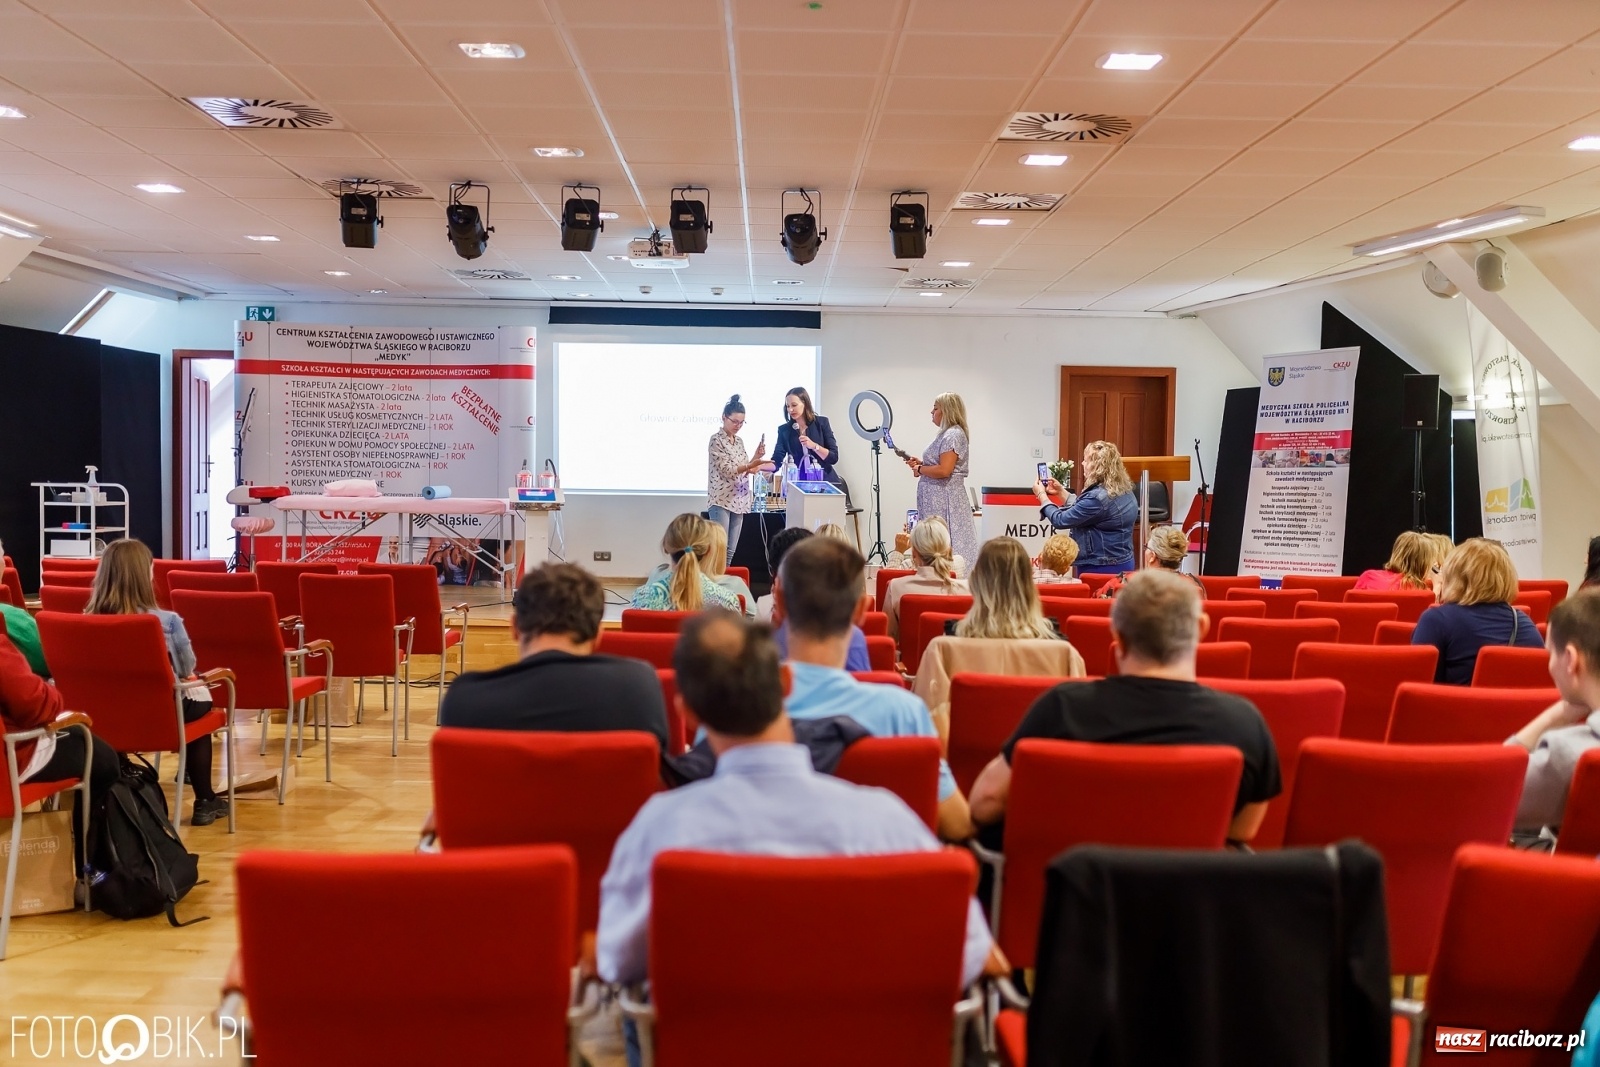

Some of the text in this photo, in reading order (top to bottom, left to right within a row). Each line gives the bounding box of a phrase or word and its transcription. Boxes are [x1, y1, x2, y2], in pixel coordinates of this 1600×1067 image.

[276, 328, 316, 337] CENTRUM
[319, 331, 373, 340] KSZTAŁCENIA
[307, 340, 372, 349] WOJEWÓDZTWA
[374, 342, 417, 352] ŚLĄSKIEGO
[353, 368, 409, 376] NASTĘPUJĄCYCH
[291, 381, 336, 389] TERAPEUTA
[339, 382, 384, 391] ZAJĘCIOWY
[291, 391, 341, 399] HIGIENISTKA
[461, 385, 502, 423] BEZPŁATNE
[291, 410, 326, 418] TECHNIK
[451, 392, 500, 435] KSZTAŁCENIE
[1304, 409, 1336, 417] ŚLĄSKIEGO
[291, 430, 337, 438] OPIEKUNKA
[340, 431, 380, 440] DZIECIĘCA
[362, 451, 439, 460] NIEPEŁNOSPRAWNEJ
